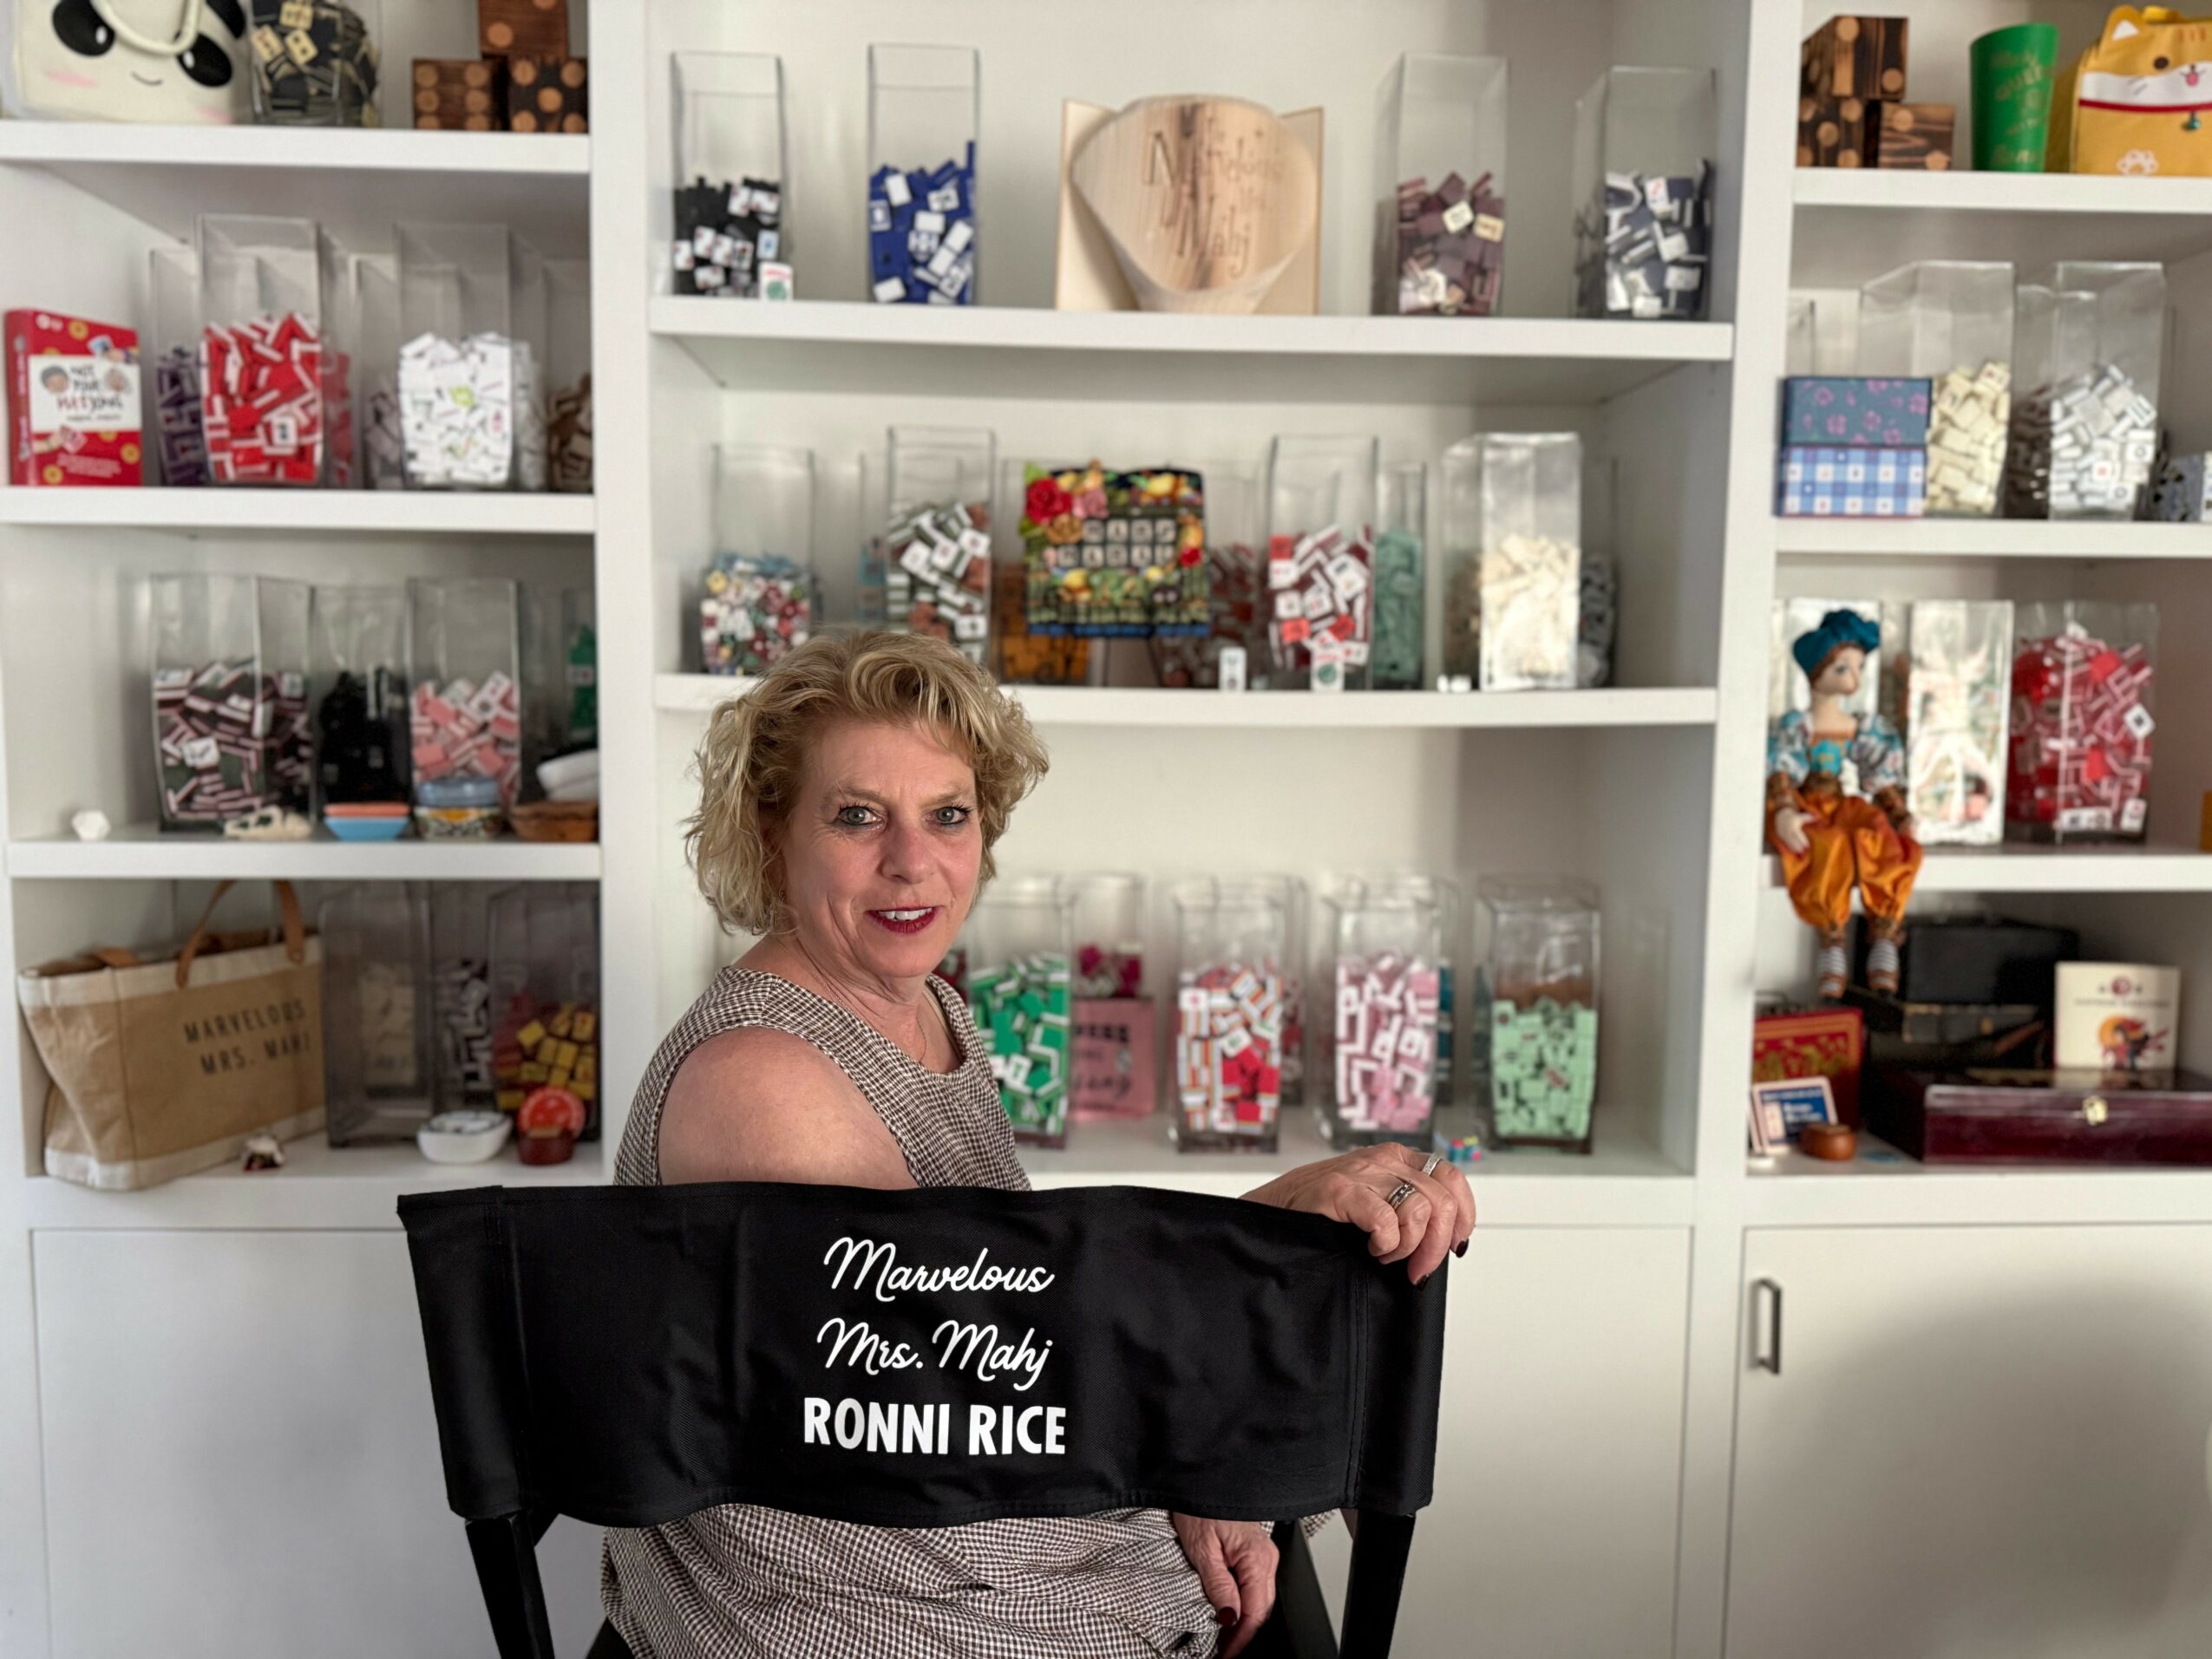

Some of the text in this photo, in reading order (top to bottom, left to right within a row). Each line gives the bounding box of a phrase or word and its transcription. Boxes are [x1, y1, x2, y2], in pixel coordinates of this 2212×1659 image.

[183, 999, 305, 1043] MARVELOUS
[200, 1045, 258, 1075] MRS.
[823, 1237, 1055, 1302] Marvelous
[816, 1317, 1053, 1391] Mrs. Mahj
[803, 1397, 1067, 1456] RONNI RICE
